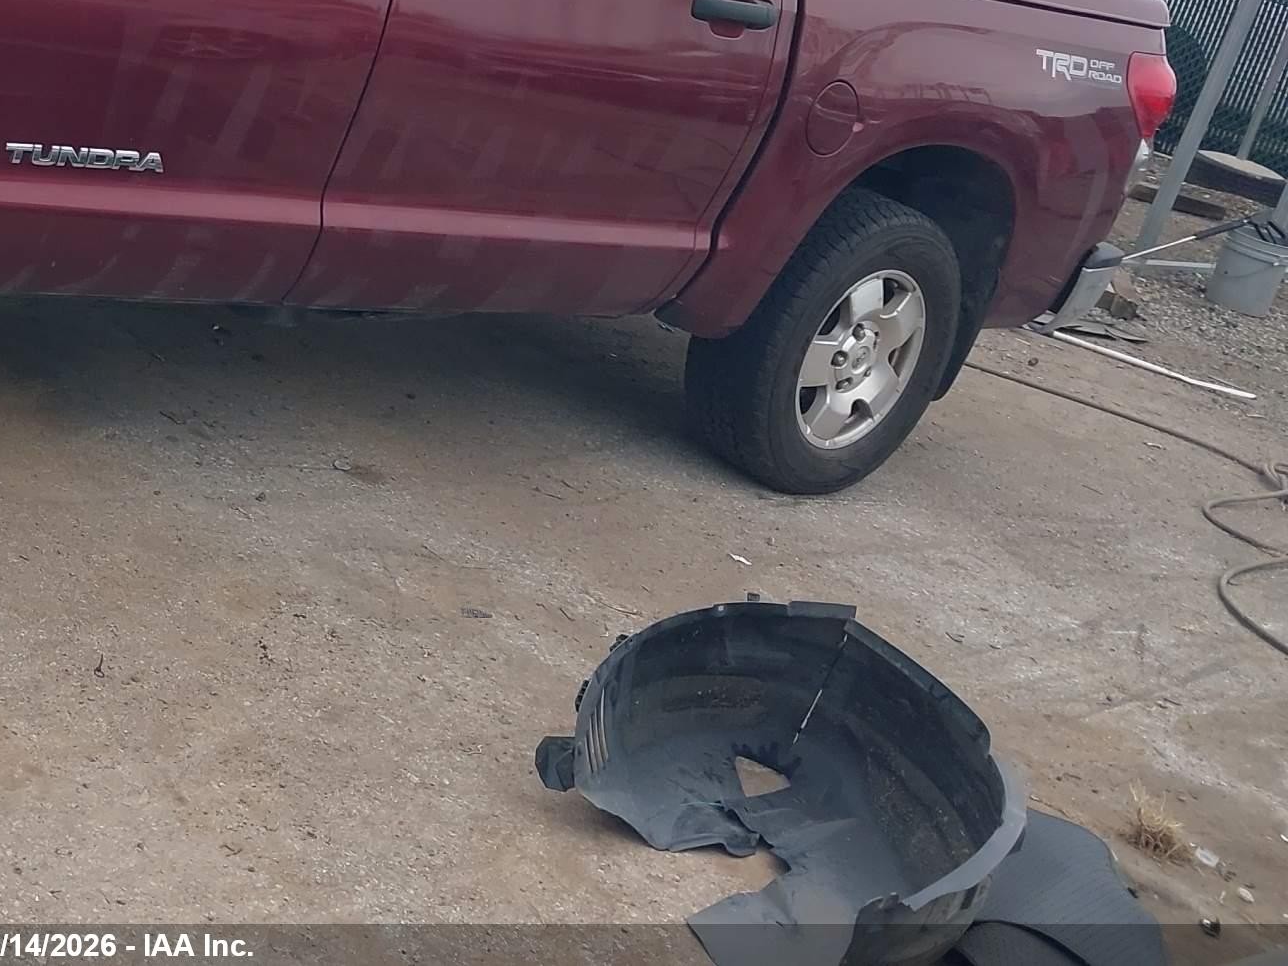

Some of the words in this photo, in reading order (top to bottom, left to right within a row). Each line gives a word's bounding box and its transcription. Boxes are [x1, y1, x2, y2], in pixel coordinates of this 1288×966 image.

[1035, 48, 1088, 81] TRD
[1089, 59, 1116, 70] OFF
[1087, 70, 1123, 84] ROAD
[6, 142, 164, 173] TUNDRA
